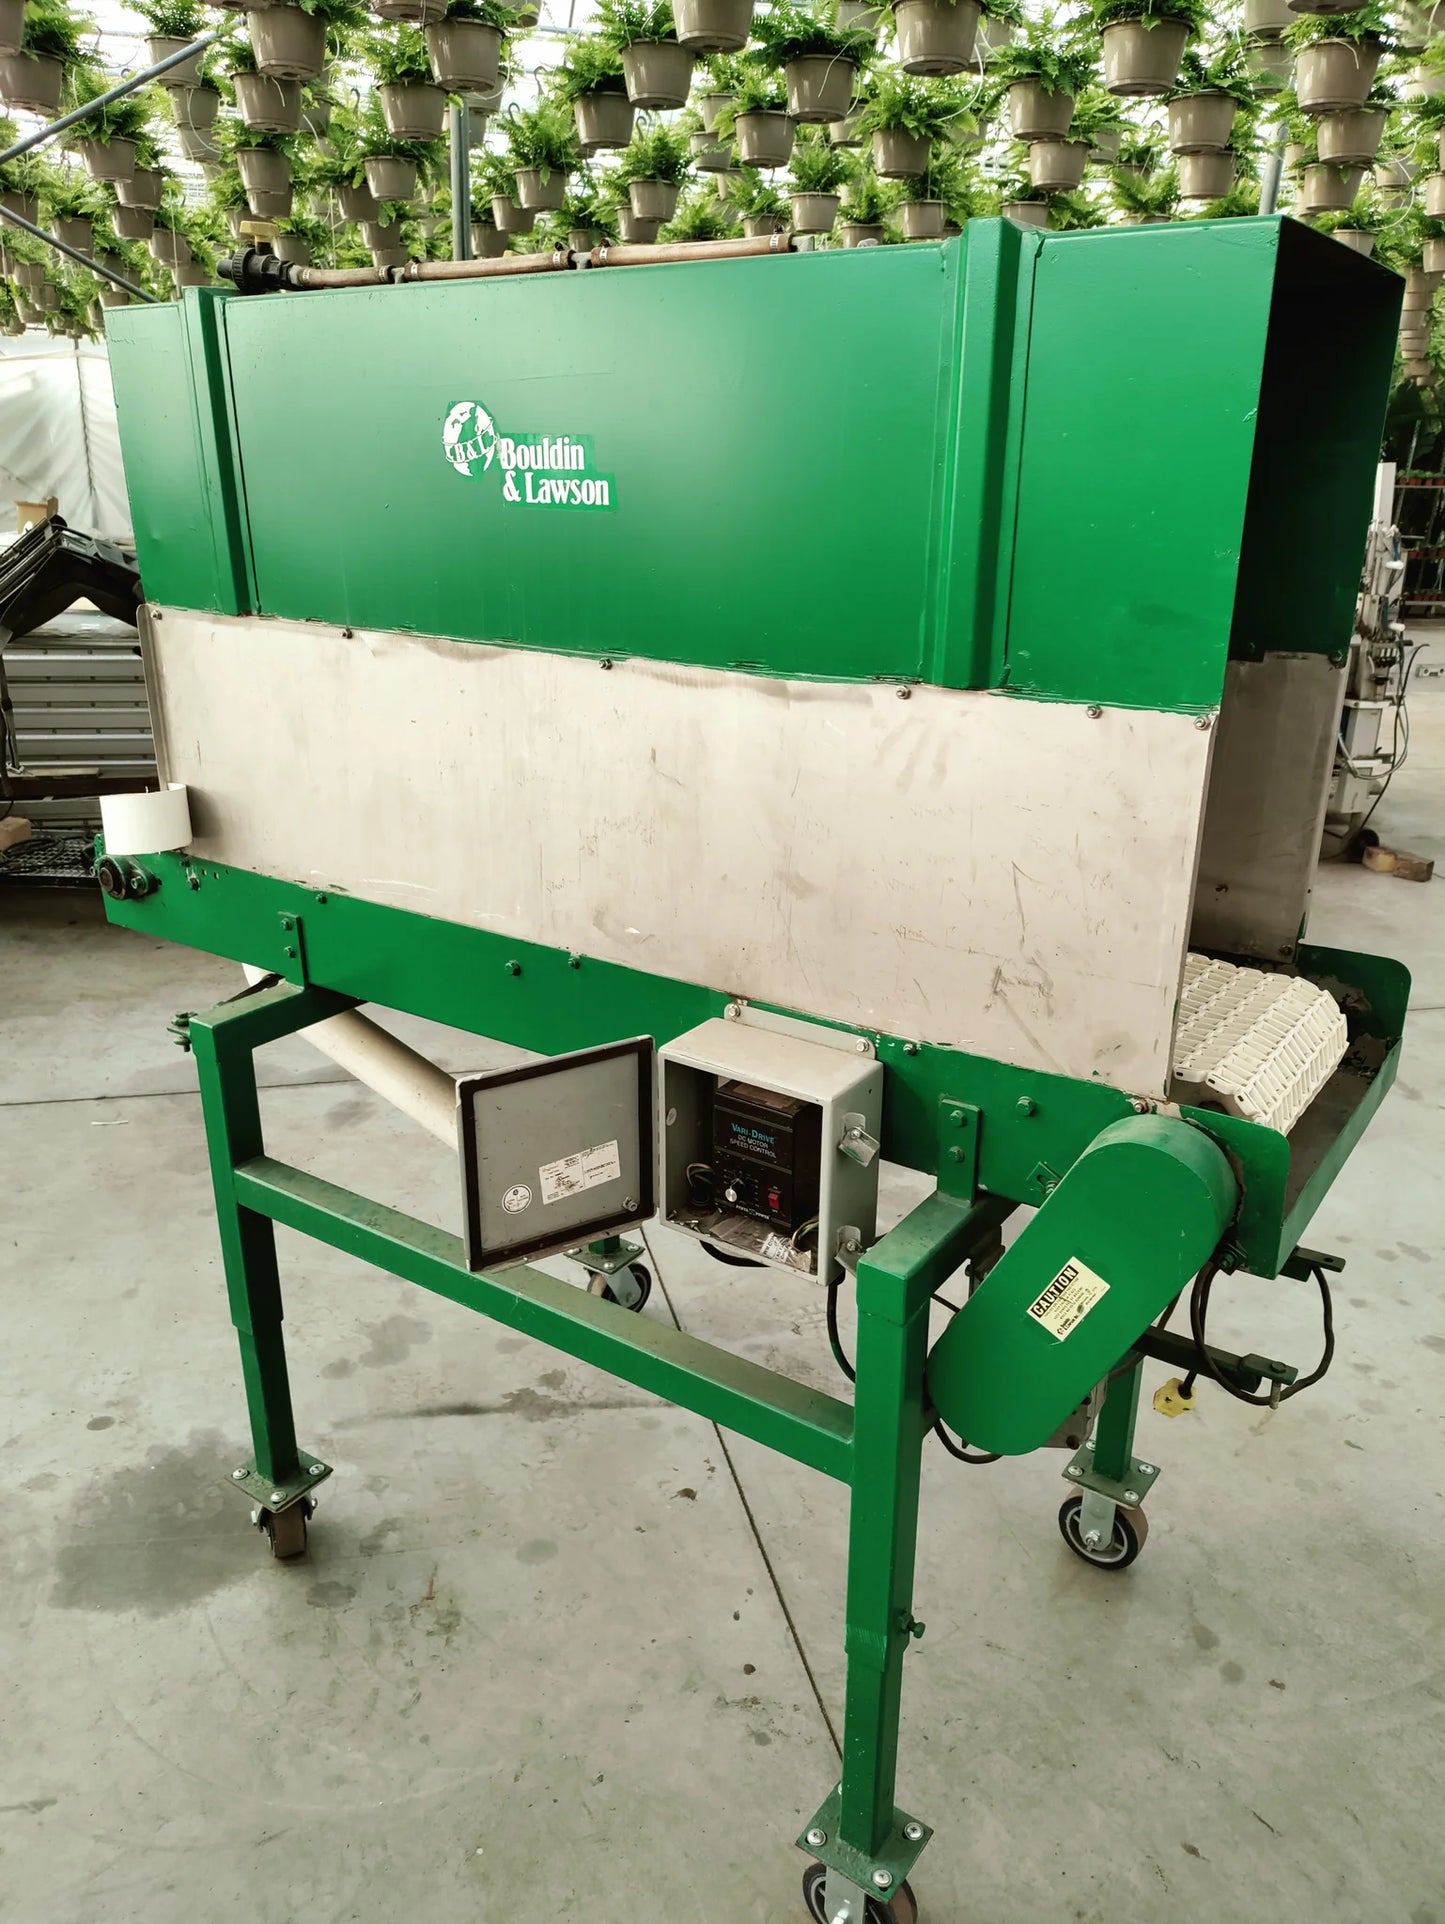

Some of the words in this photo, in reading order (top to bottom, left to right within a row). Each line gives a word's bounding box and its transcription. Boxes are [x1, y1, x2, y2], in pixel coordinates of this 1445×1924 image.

[501, 436, 585, 471] Bouldin
[503, 470, 522, 502] &
[524, 472, 610, 506] Lawson
[730, 1138, 749, 1150] SPEED
[749, 1143, 777, 1158] CONTROL
[738, 1134, 748, 1143] DC
[748, 1137, 769, 1149] MOTOR
[1033, 1267, 1077, 1316] CAUTION
